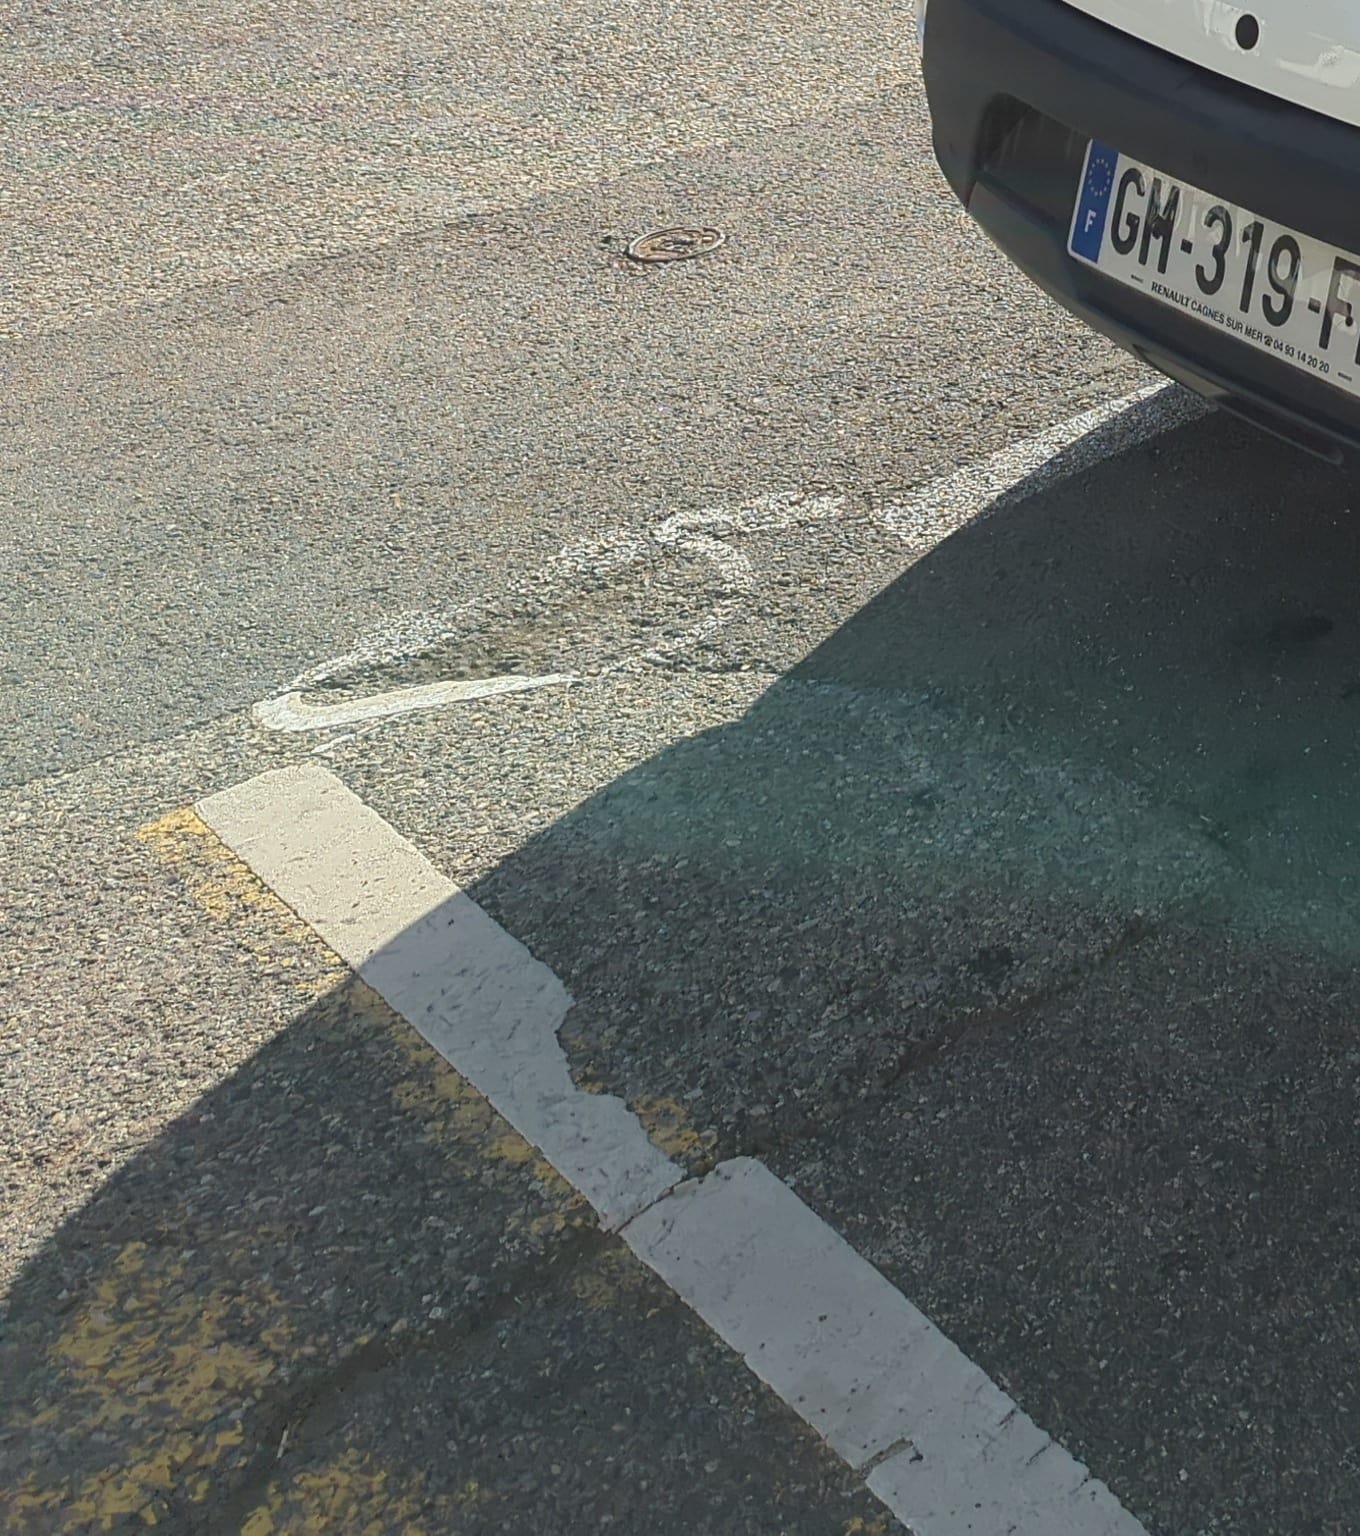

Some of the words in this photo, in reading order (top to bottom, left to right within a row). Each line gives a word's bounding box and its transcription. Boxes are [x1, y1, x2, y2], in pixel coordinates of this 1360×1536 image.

[1085, 209, 1096, 233] F
[1151, 280, 1190, 307] RENAULT
[1191, 300, 1225, 324] CAGNES
[1226, 317, 1243, 333] SUR
[1245, 325, 1263, 343] MER
[1273, 340, 1283, 351] 04
[1285, 344, 1295, 357] 93
[1297, 350, 1306, 362] 14
[1307, 355, 1318, 368] 20
[1318, 360, 1330, 373] 20
